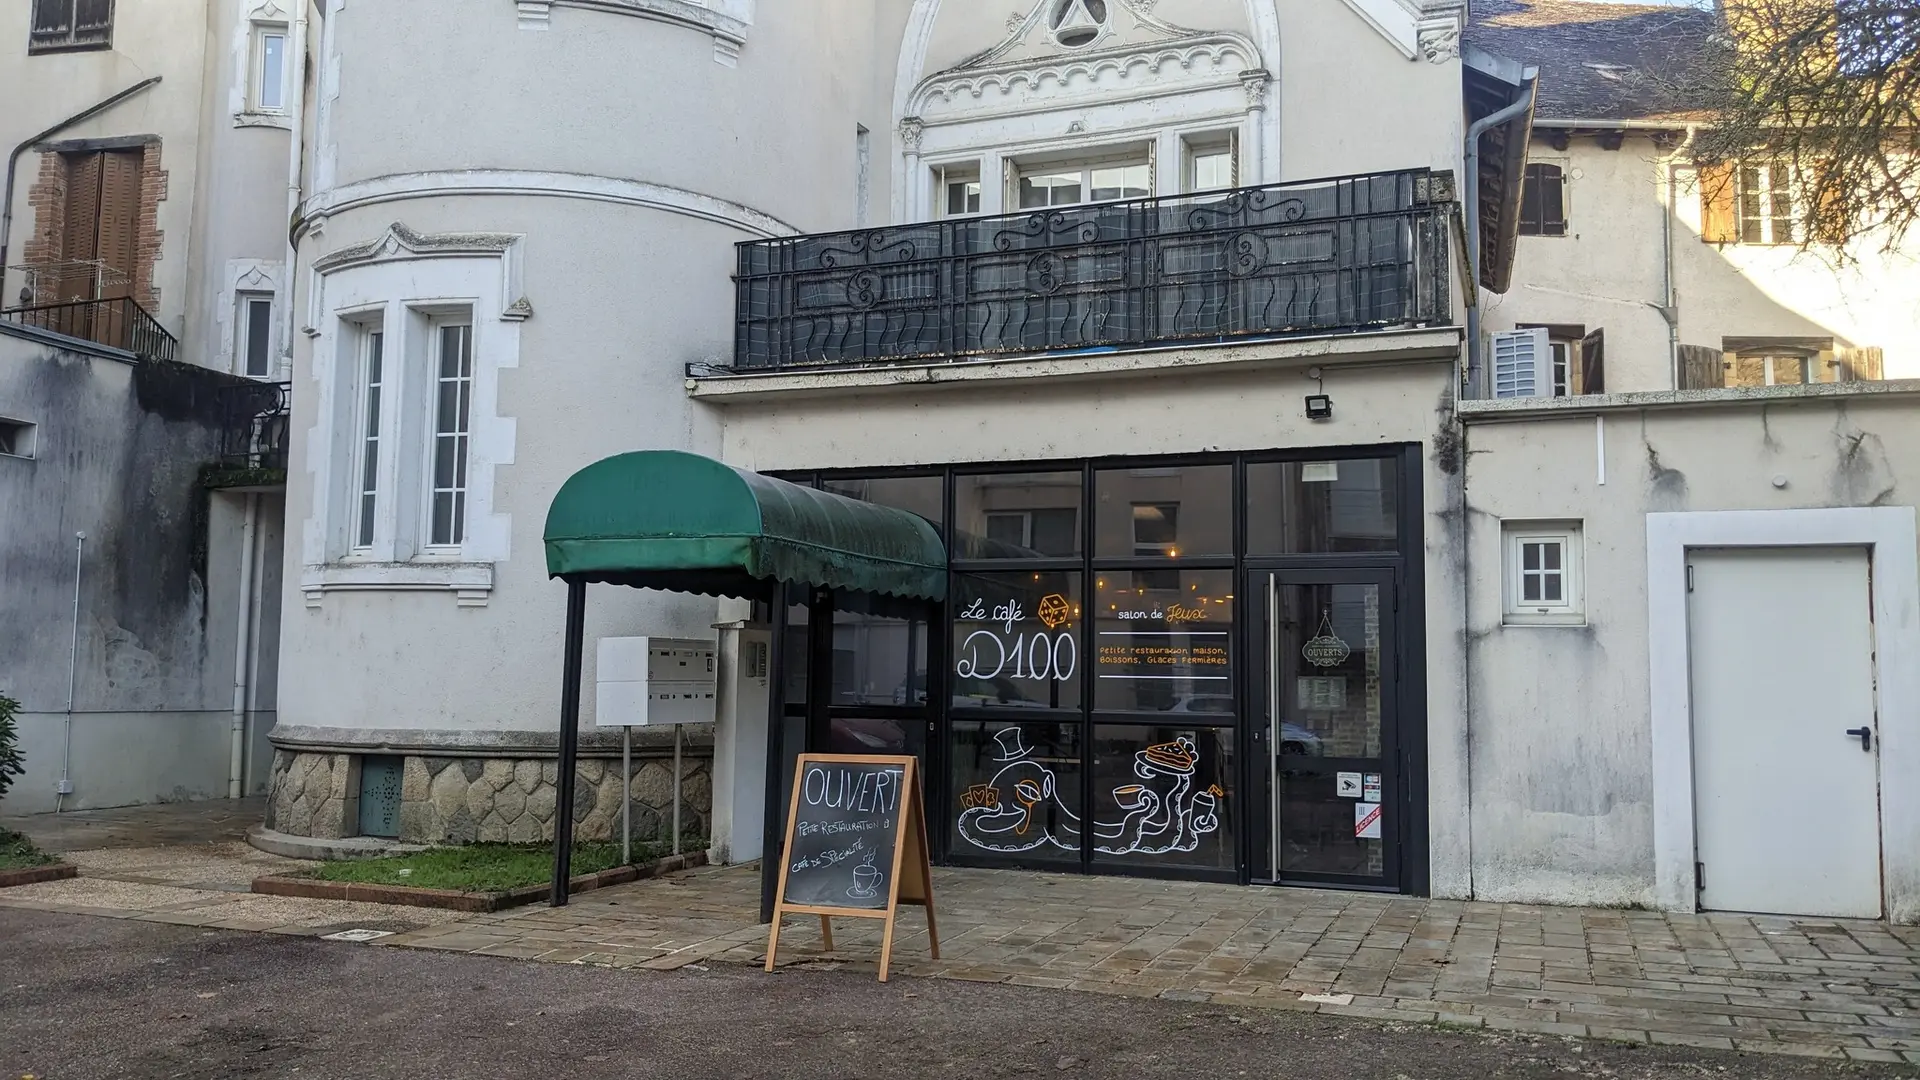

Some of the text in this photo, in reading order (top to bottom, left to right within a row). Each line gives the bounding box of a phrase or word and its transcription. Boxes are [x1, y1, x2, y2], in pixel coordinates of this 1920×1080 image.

[961, 598, 987, 620] Le
[1118, 603, 1207, 622] salon de Jeux
[957, 630, 1076, 681] D100
[805, 768, 903, 813] OUVERT
[1355, 807, 1381, 834] LICENCE
[811, 858, 822, 867] DE
